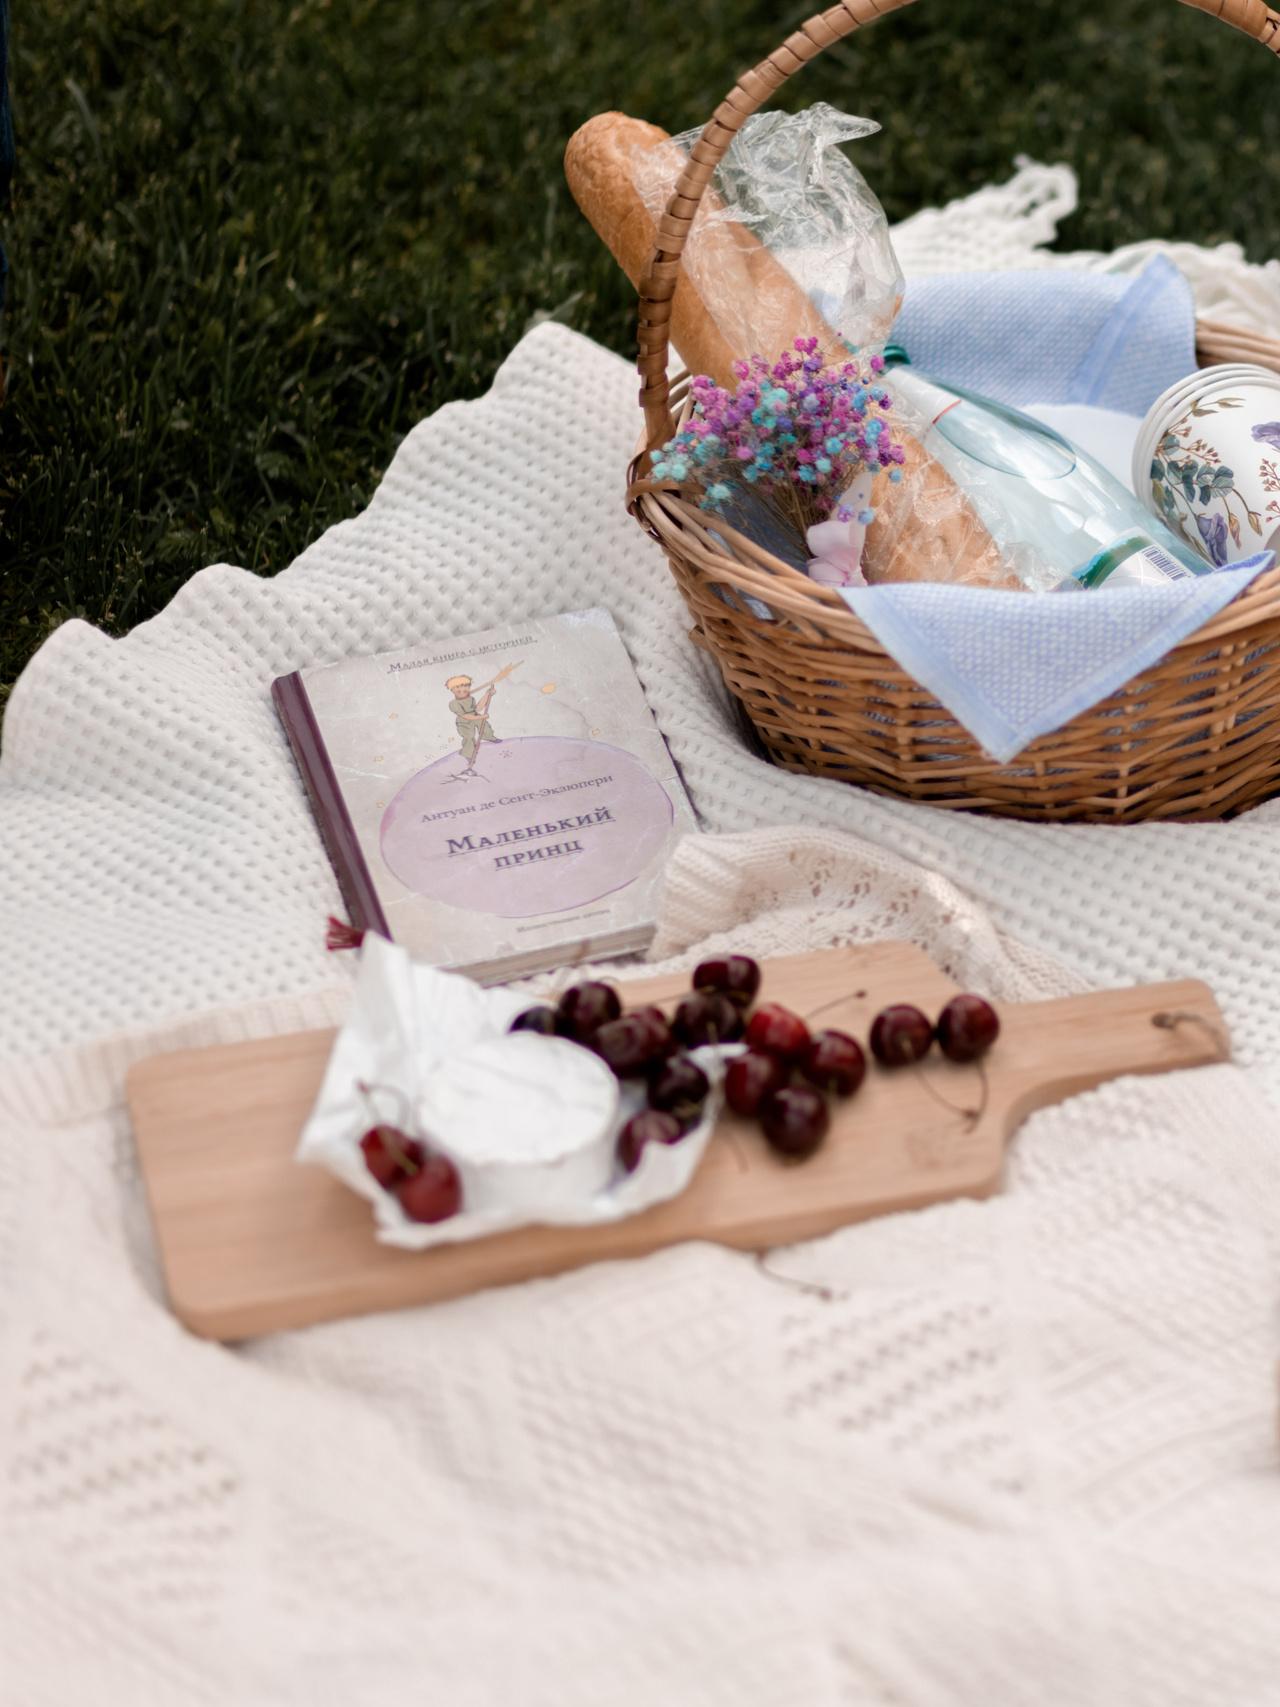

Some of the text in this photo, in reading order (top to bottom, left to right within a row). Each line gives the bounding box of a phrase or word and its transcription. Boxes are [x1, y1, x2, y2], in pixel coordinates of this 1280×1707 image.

[421, 775, 614, 823] Антуан де Сент-Экзюпери
